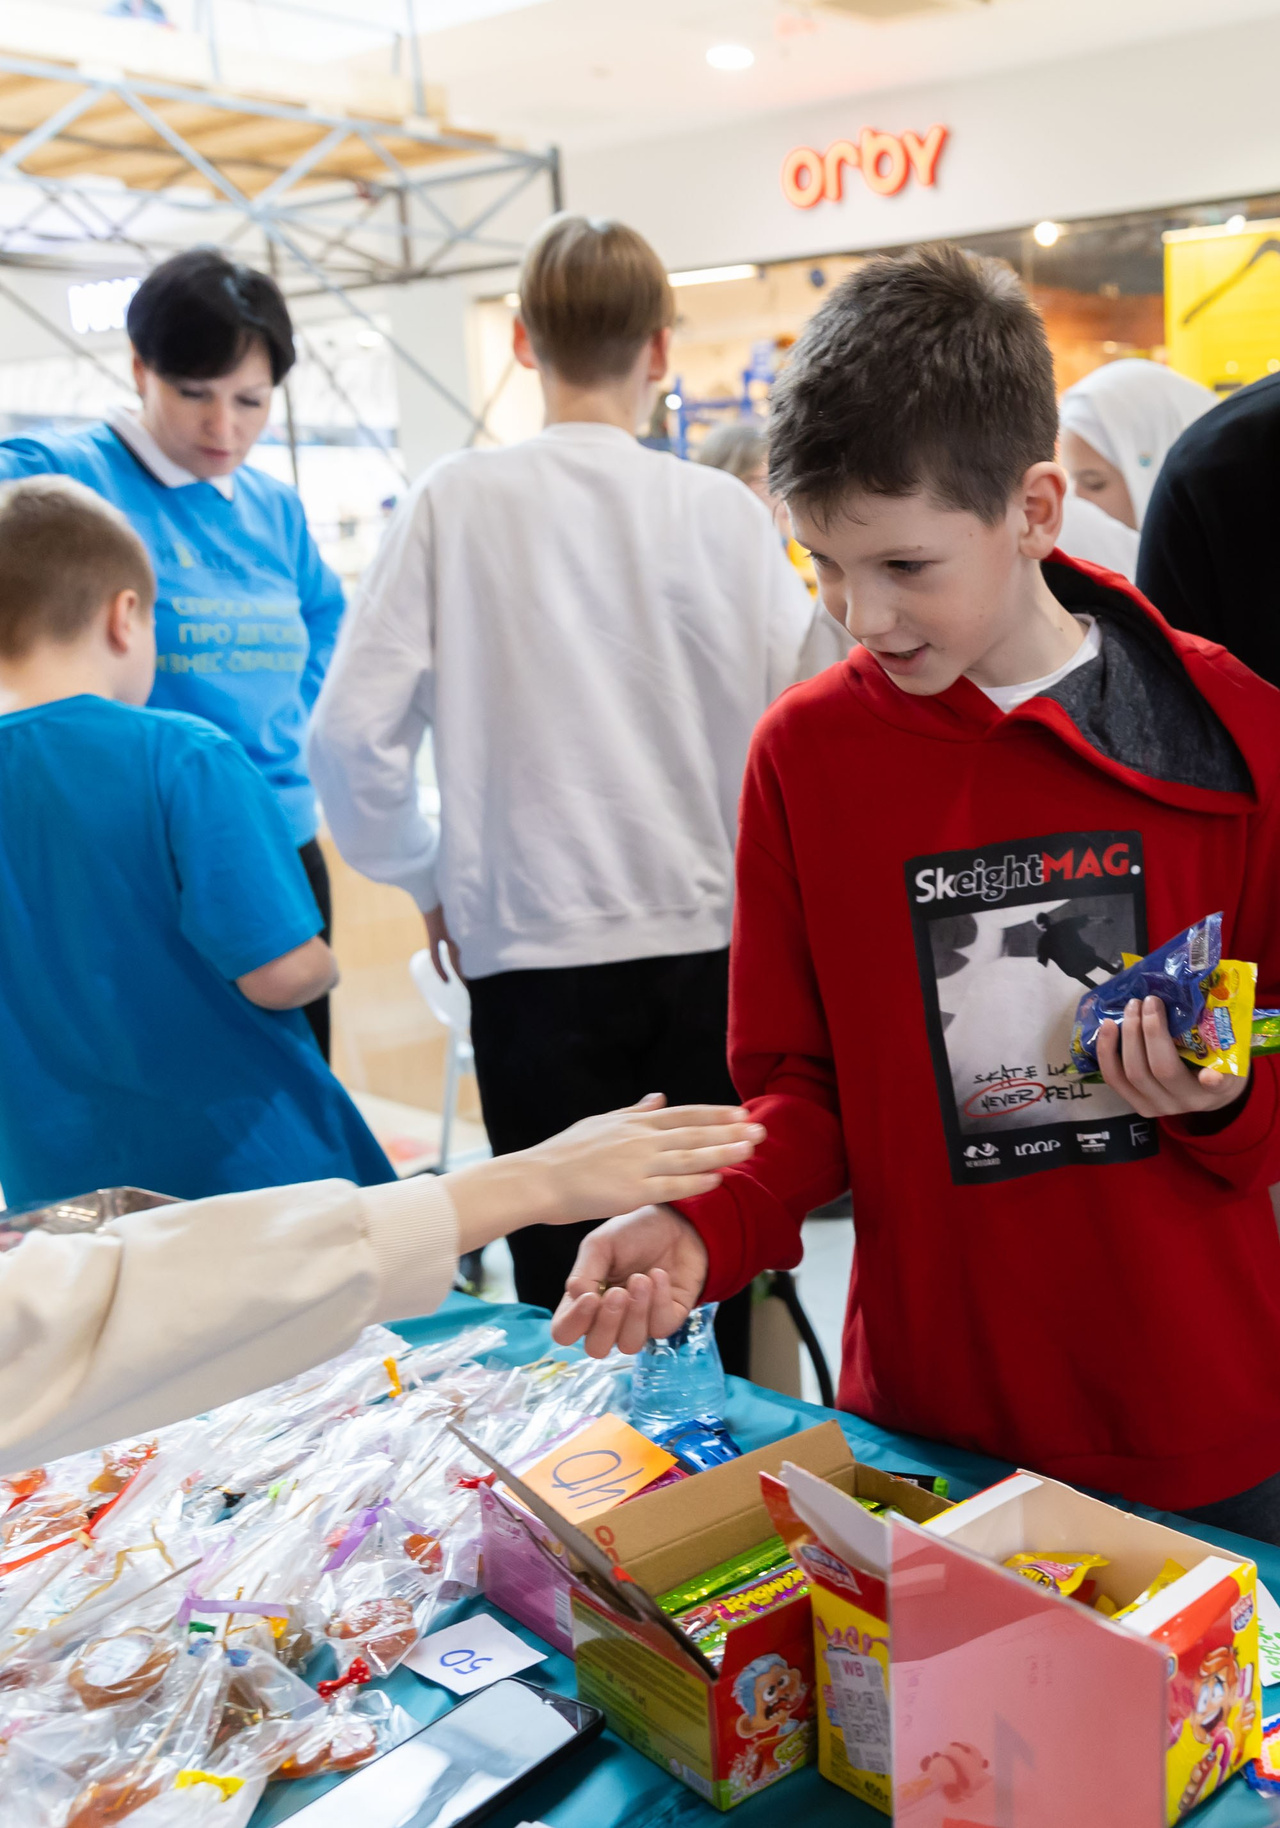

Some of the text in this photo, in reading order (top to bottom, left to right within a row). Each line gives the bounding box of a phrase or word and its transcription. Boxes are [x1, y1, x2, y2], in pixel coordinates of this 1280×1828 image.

[178, 622, 231, 645] ПРО
[973, 1064, 1038, 1088] SKATE
[980, 1082, 1093, 1113] NEVER FELL
[439, 1649, 494, 1675] 50
